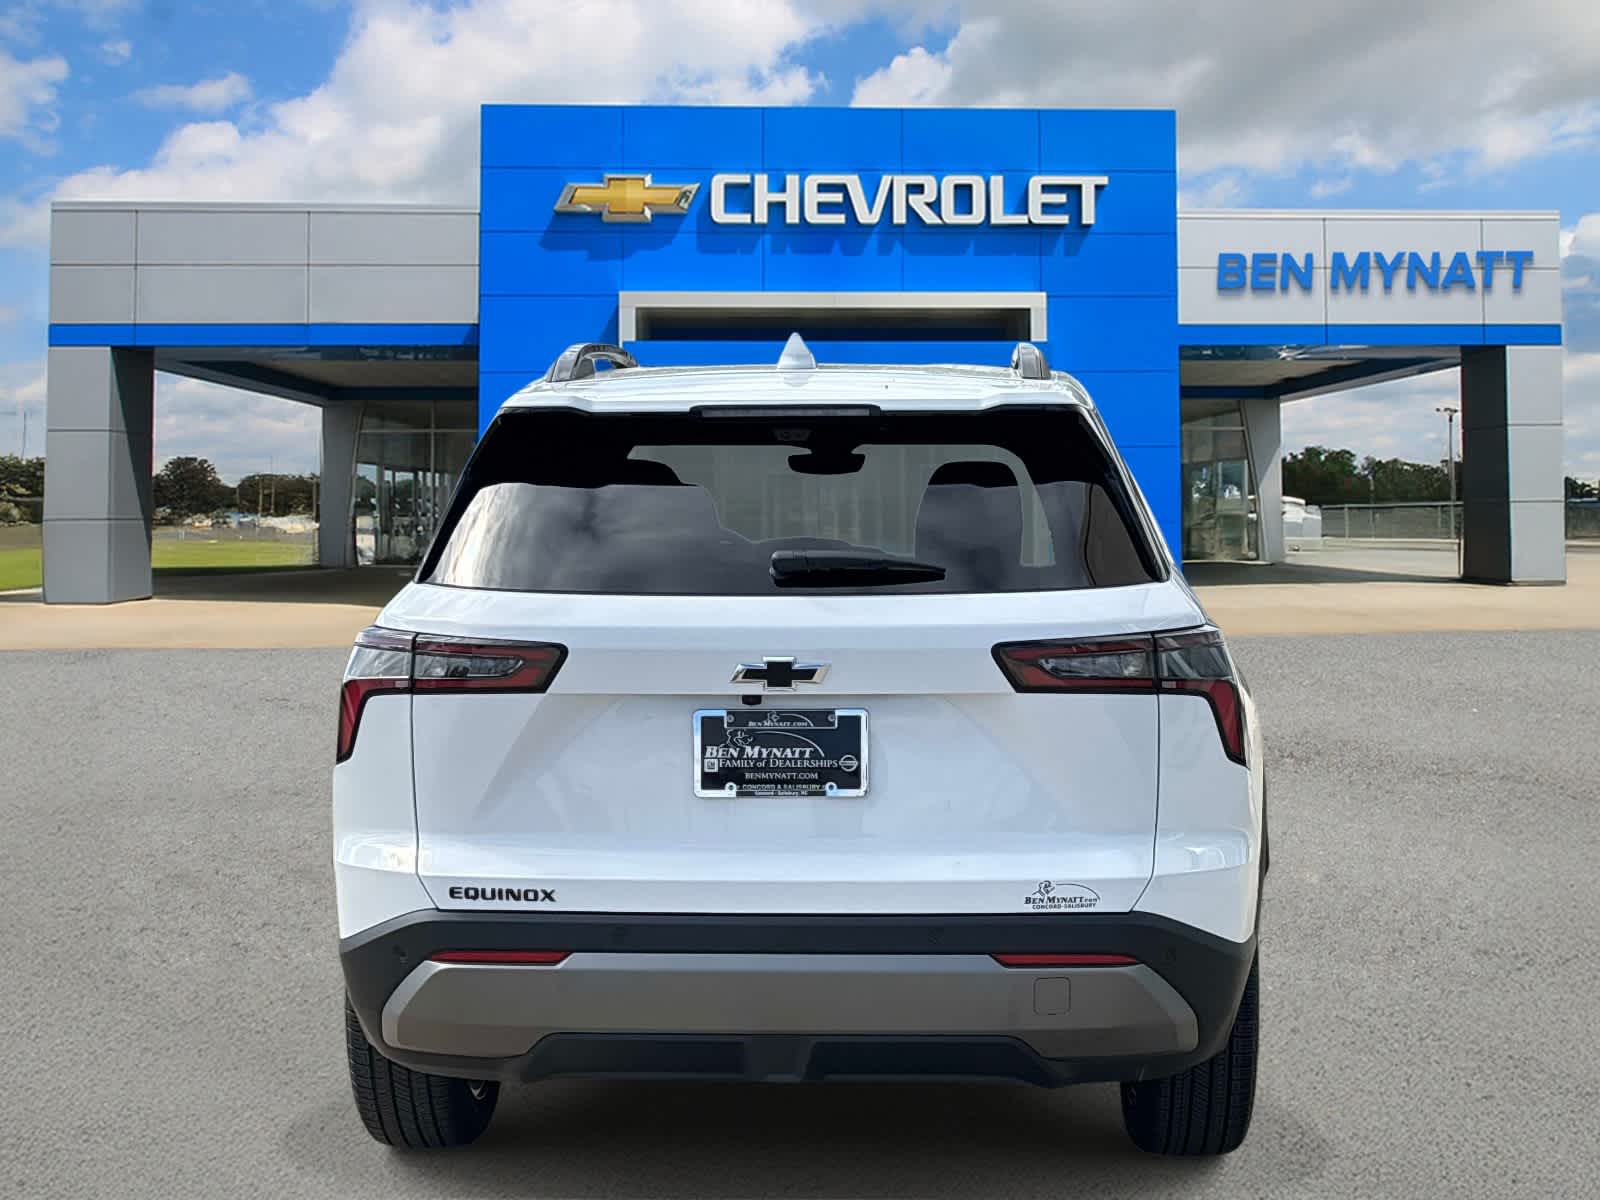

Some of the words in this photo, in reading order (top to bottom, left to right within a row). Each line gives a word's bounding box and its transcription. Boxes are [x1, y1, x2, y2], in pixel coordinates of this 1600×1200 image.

[710, 173, 1109, 225] CHEVROLET
[1217, 252, 1314, 290] BEN
[1330, 250, 1534, 290] MYNATT
[704, 745, 740, 758] BEN
[742, 745, 814, 758] MYNATT
[719, 759, 755, 768] FAMILY
[756, 759, 768, 768] of
[769, 758, 838, 768] DEALERSHIPS
[744, 772, 819, 780] BENMYNATT.COM
[448, 886, 557, 902] EQUINOX
